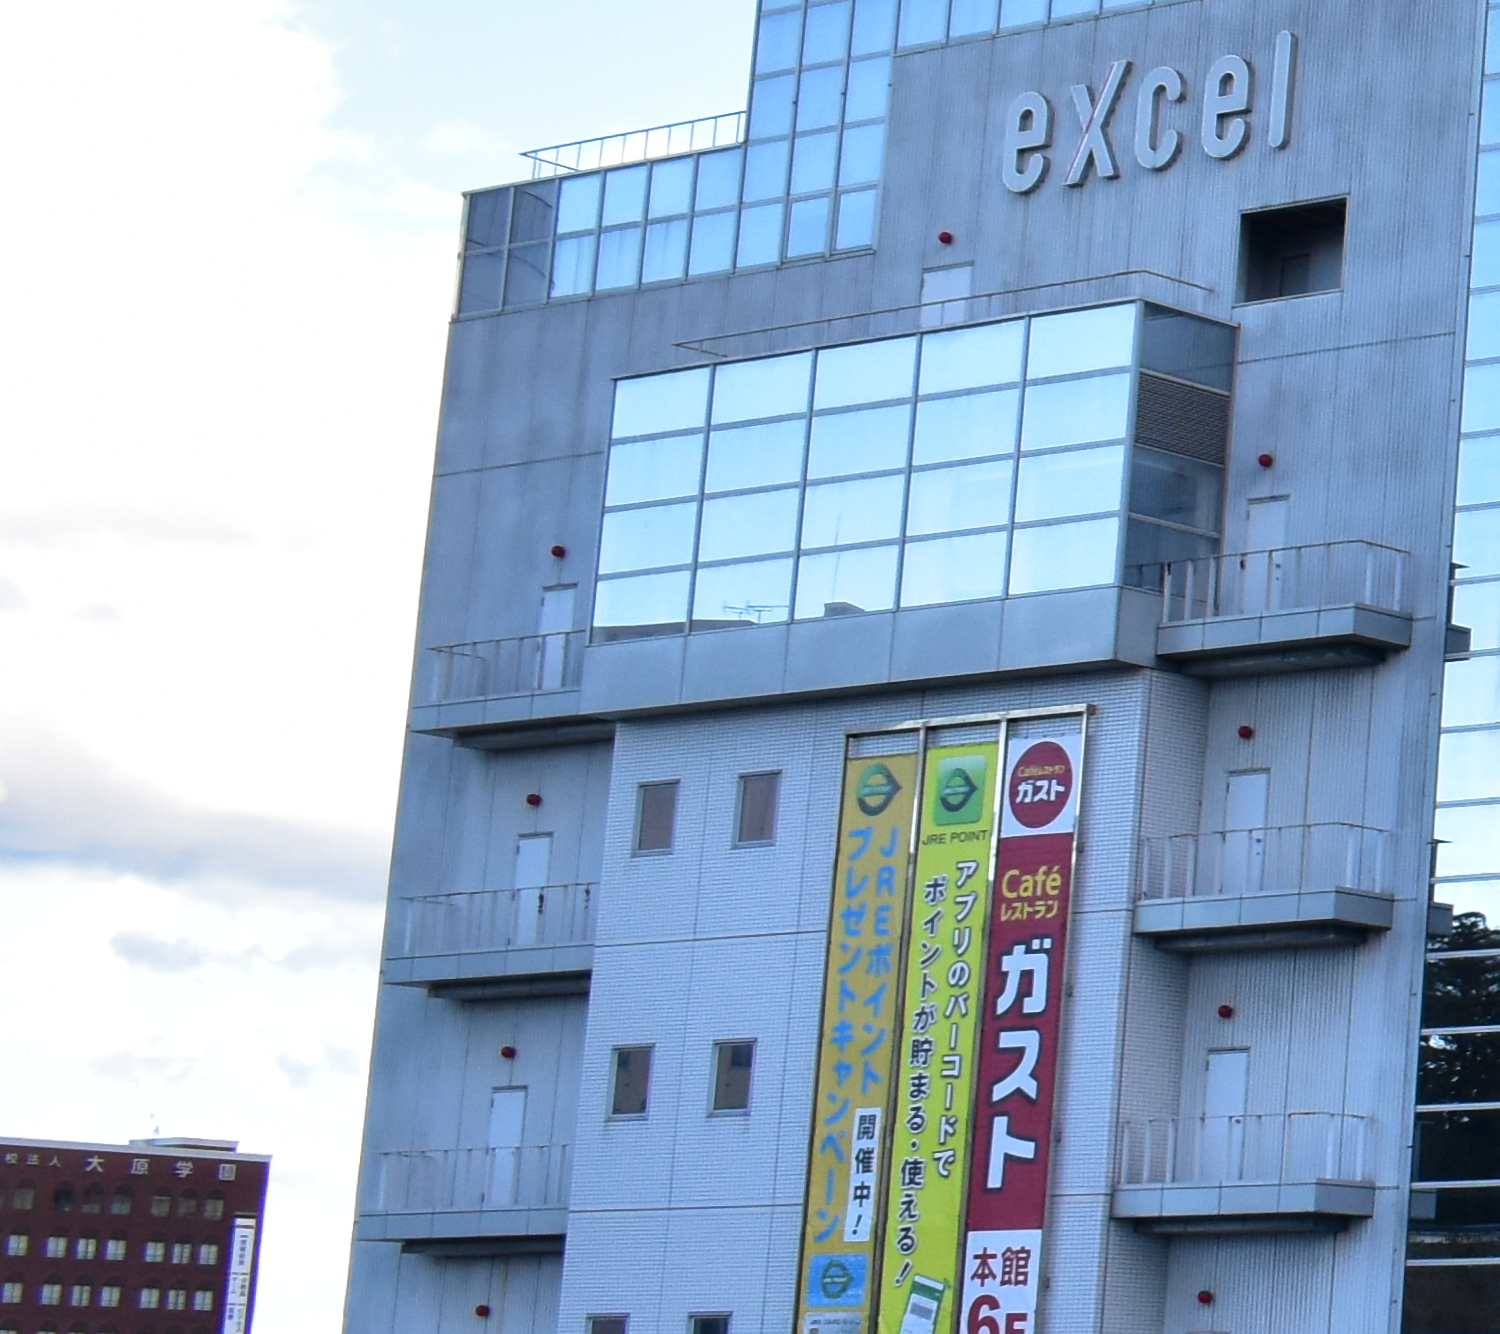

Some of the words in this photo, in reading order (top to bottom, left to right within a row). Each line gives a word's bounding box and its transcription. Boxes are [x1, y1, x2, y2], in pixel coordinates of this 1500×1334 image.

[1002, 30, 1298, 194] excel
[1016, 778, 1065, 803] ガスト
[922, 832, 946, 846] JRE
[951, 829, 988, 843] POINT
[1001, 865, 1063, 899] Café
[1000, 899, 1059, 922] レストラン
[860, 826, 899, 1095] JREポイント
[933, 860, 980, 1177] アプリのバーコードで
[986, 937, 1053, 1190] ガスト
[970, 1246, 1031, 1288] 本館
